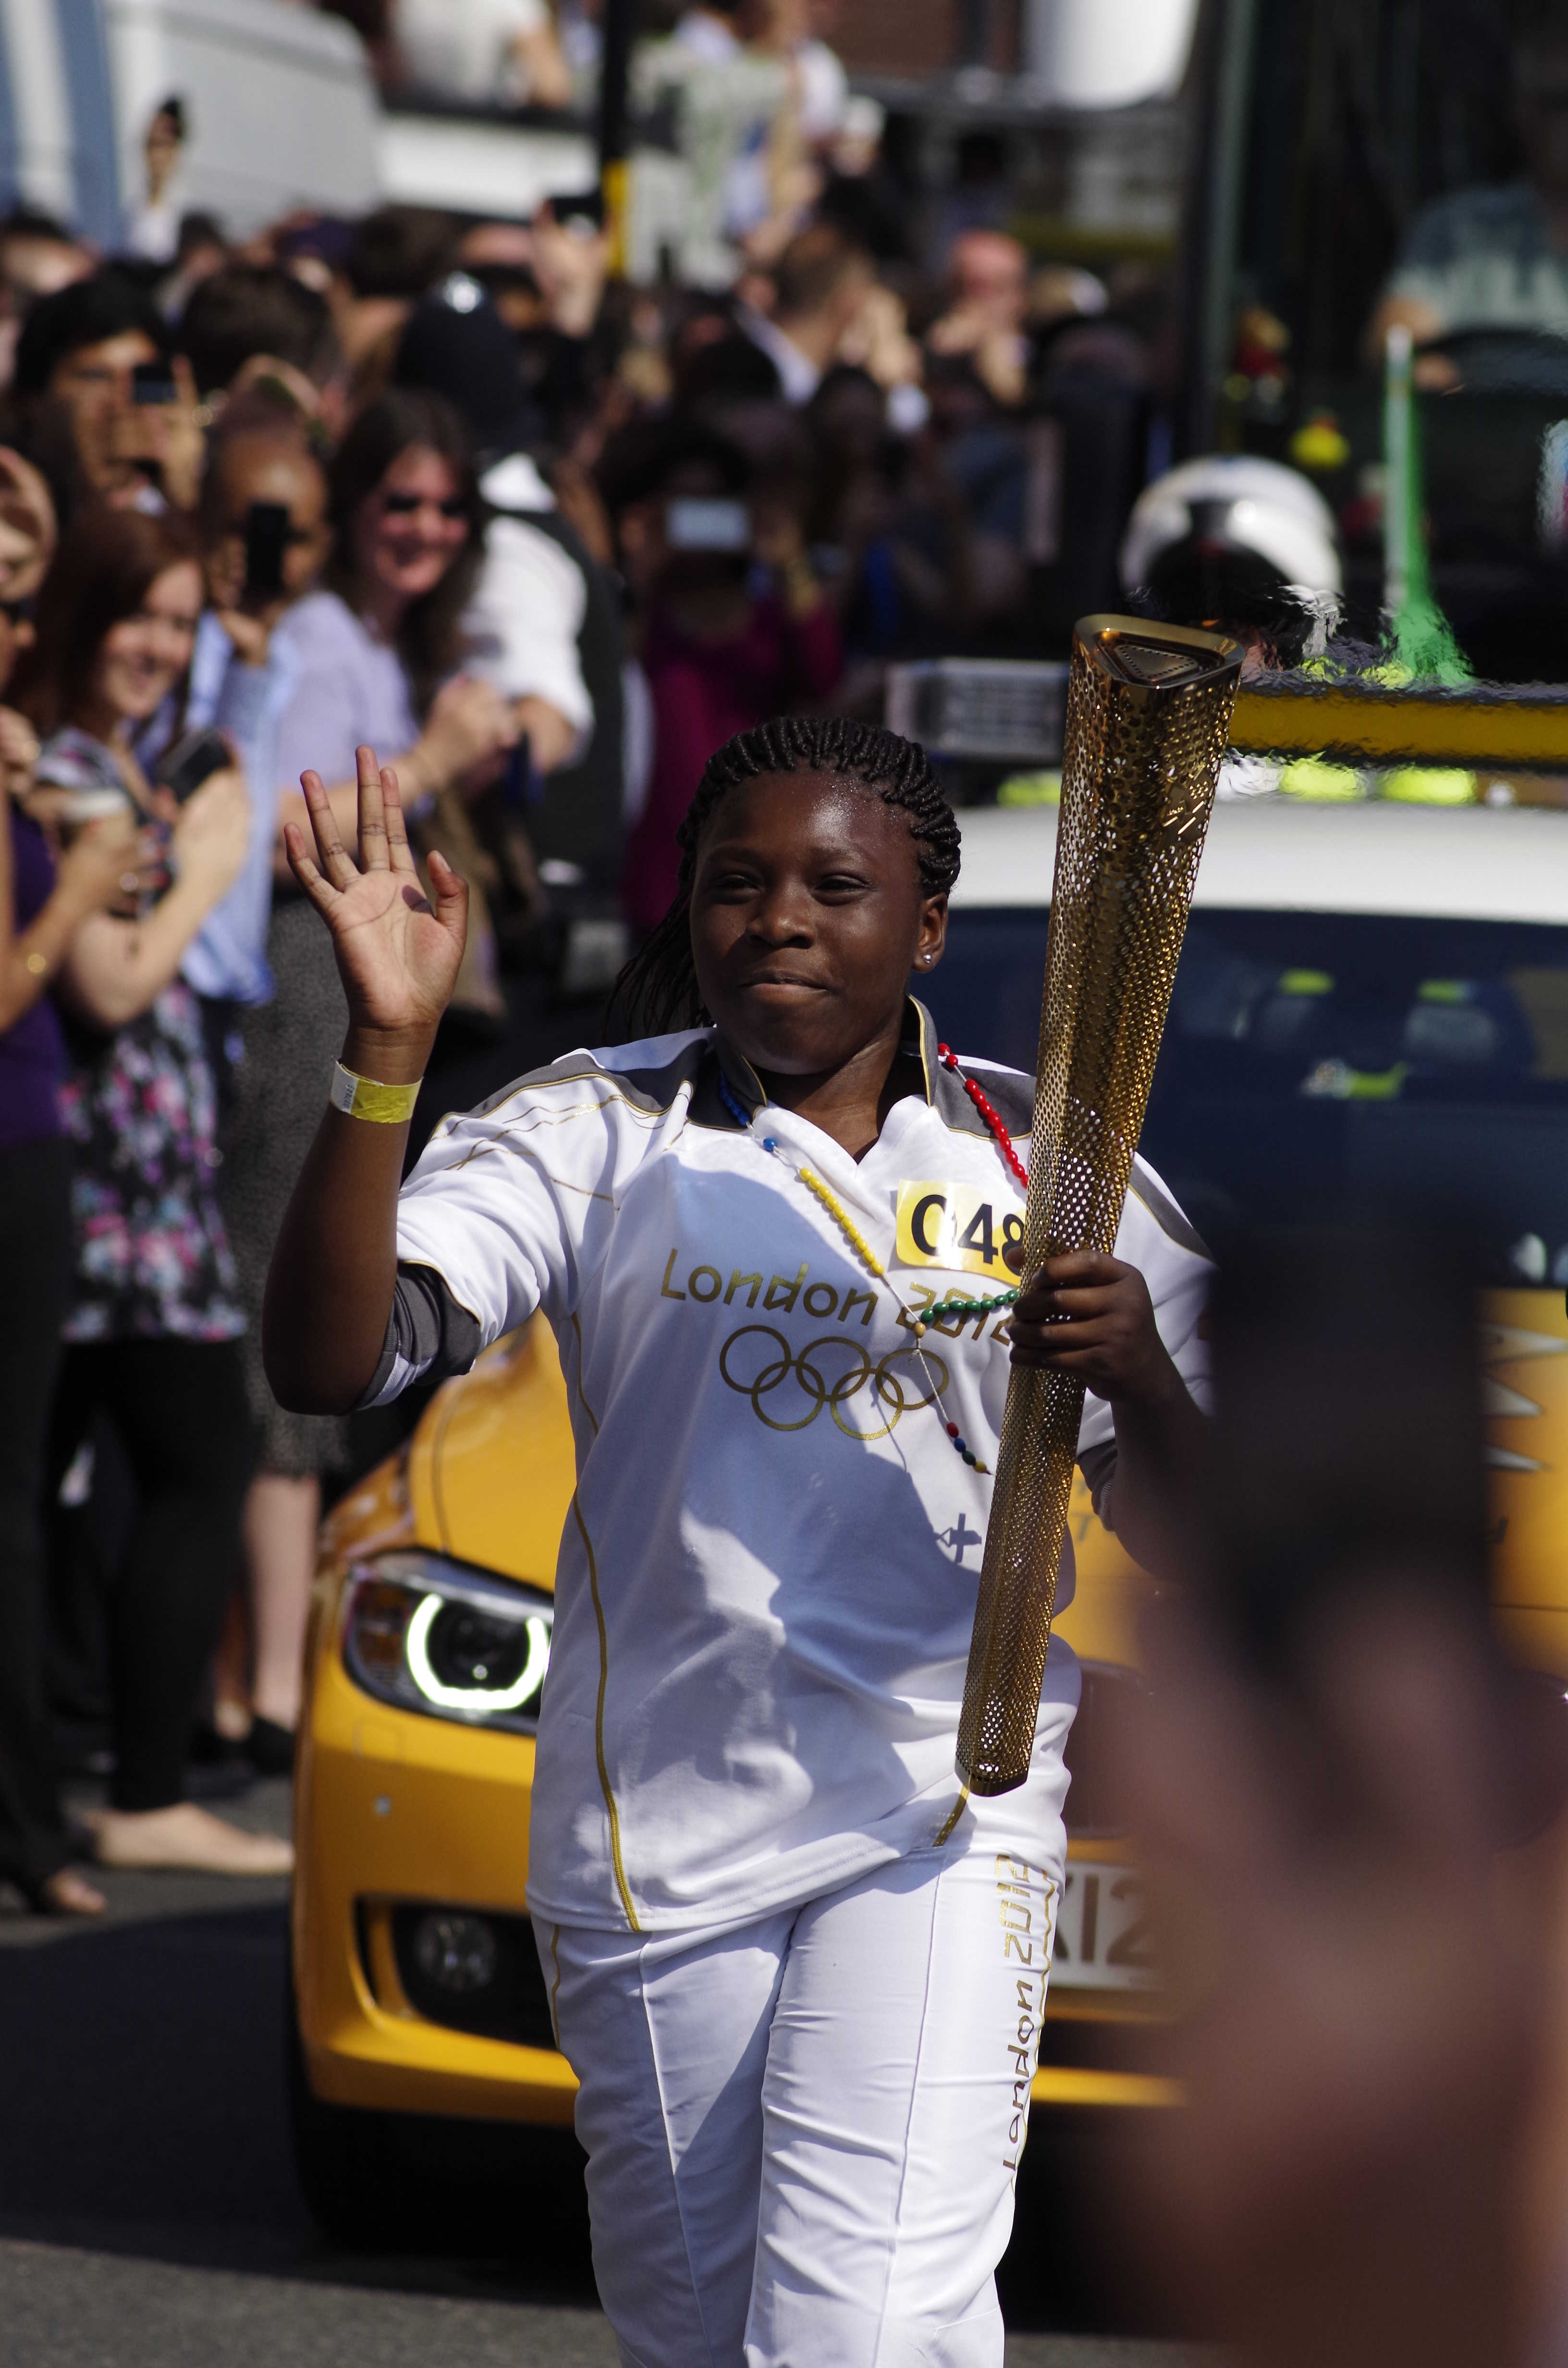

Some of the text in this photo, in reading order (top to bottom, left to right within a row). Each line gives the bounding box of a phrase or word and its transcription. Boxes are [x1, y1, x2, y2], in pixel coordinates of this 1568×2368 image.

[661, 1247, 879, 1326] London
[994, 1854, 1034, 2171] London 2012
